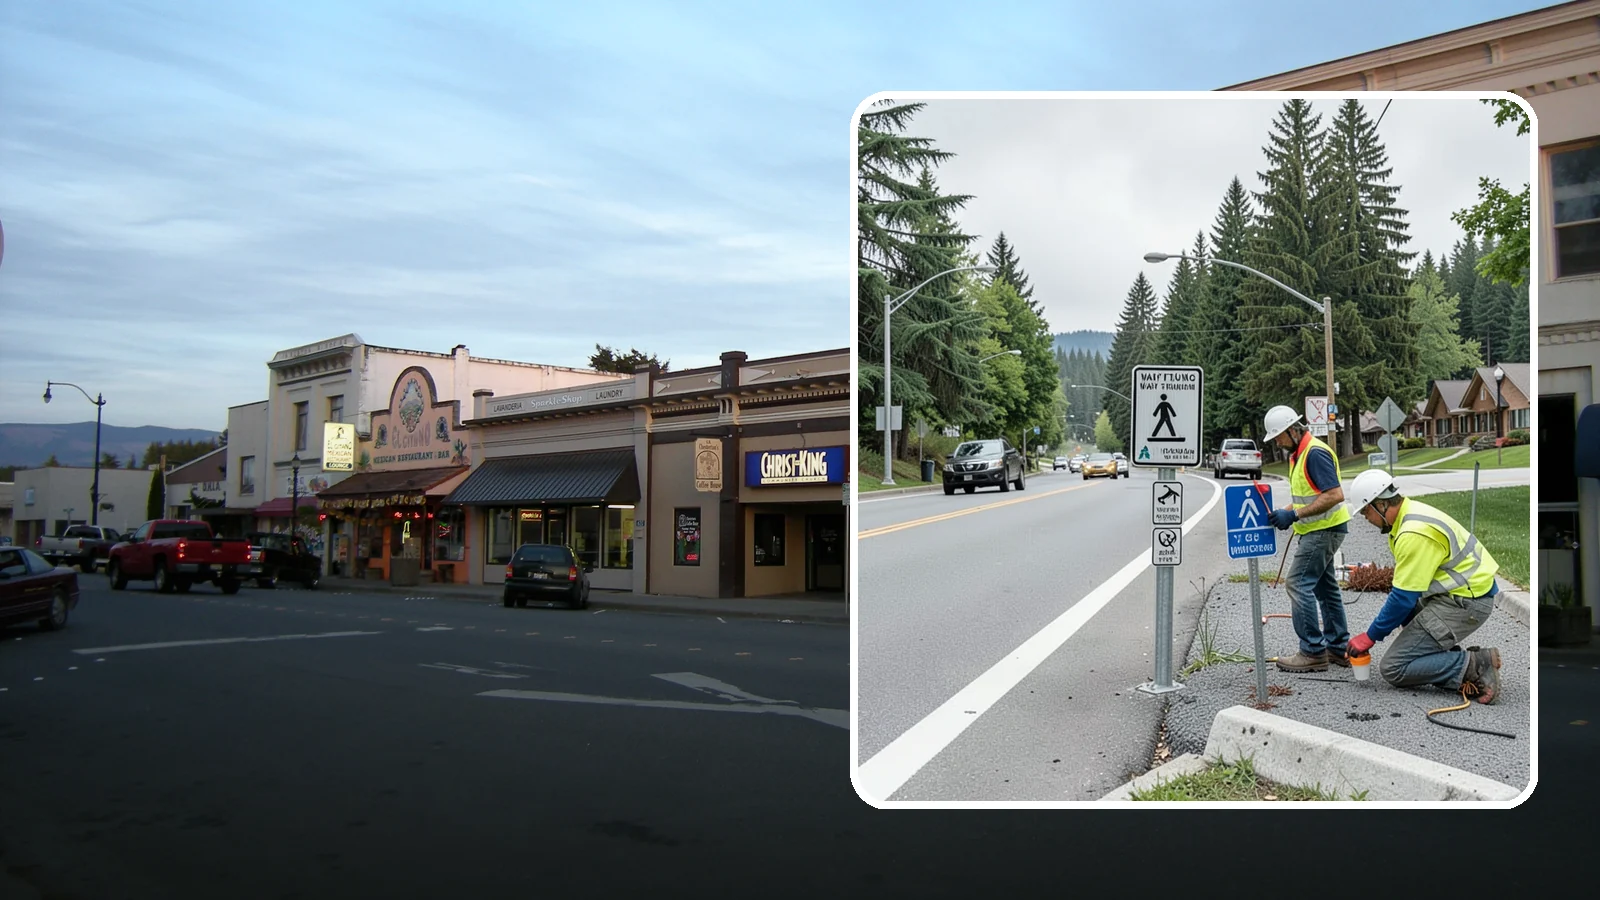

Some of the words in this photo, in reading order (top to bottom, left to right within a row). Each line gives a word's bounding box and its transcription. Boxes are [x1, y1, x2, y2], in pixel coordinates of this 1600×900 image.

[493, 402, 523, 413] LAVANDERIA
[530, 398, 561, 409] Sparkle
[561, 394, 583, 405] Shop
[595, 389, 624, 400] LAUNDRY
[373, 454, 396, 464] MEXICAN
[397, 451, 433, 462] RESTAURANT
[438, 450, 450, 459] BAR
[760, 452, 797, 478] CHRIST
[799, 450, 827, 476] KING
